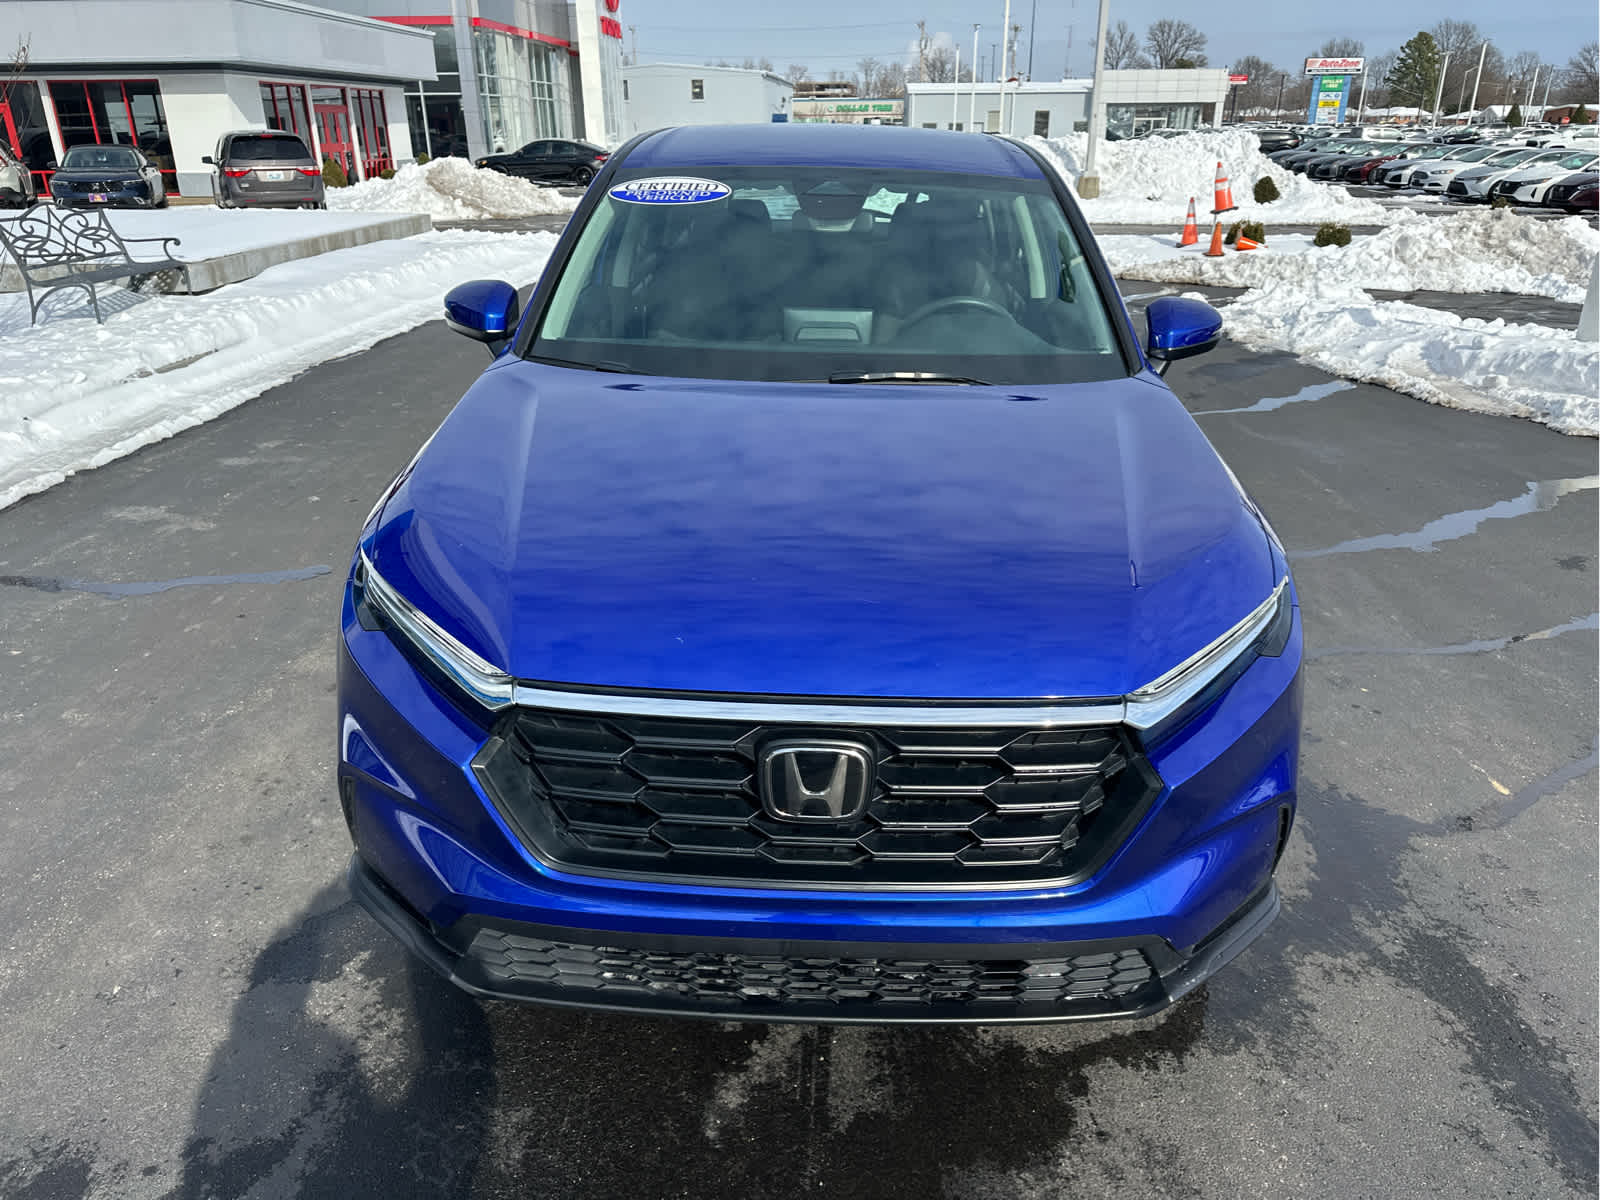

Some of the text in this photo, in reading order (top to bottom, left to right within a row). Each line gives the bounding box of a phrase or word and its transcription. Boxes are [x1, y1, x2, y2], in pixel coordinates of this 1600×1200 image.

[1319, 59, 1360, 68] AutoZone
[836, 104, 893, 112] DOLLAR TREE
[624, 182, 719, 191] CERTIFIED
